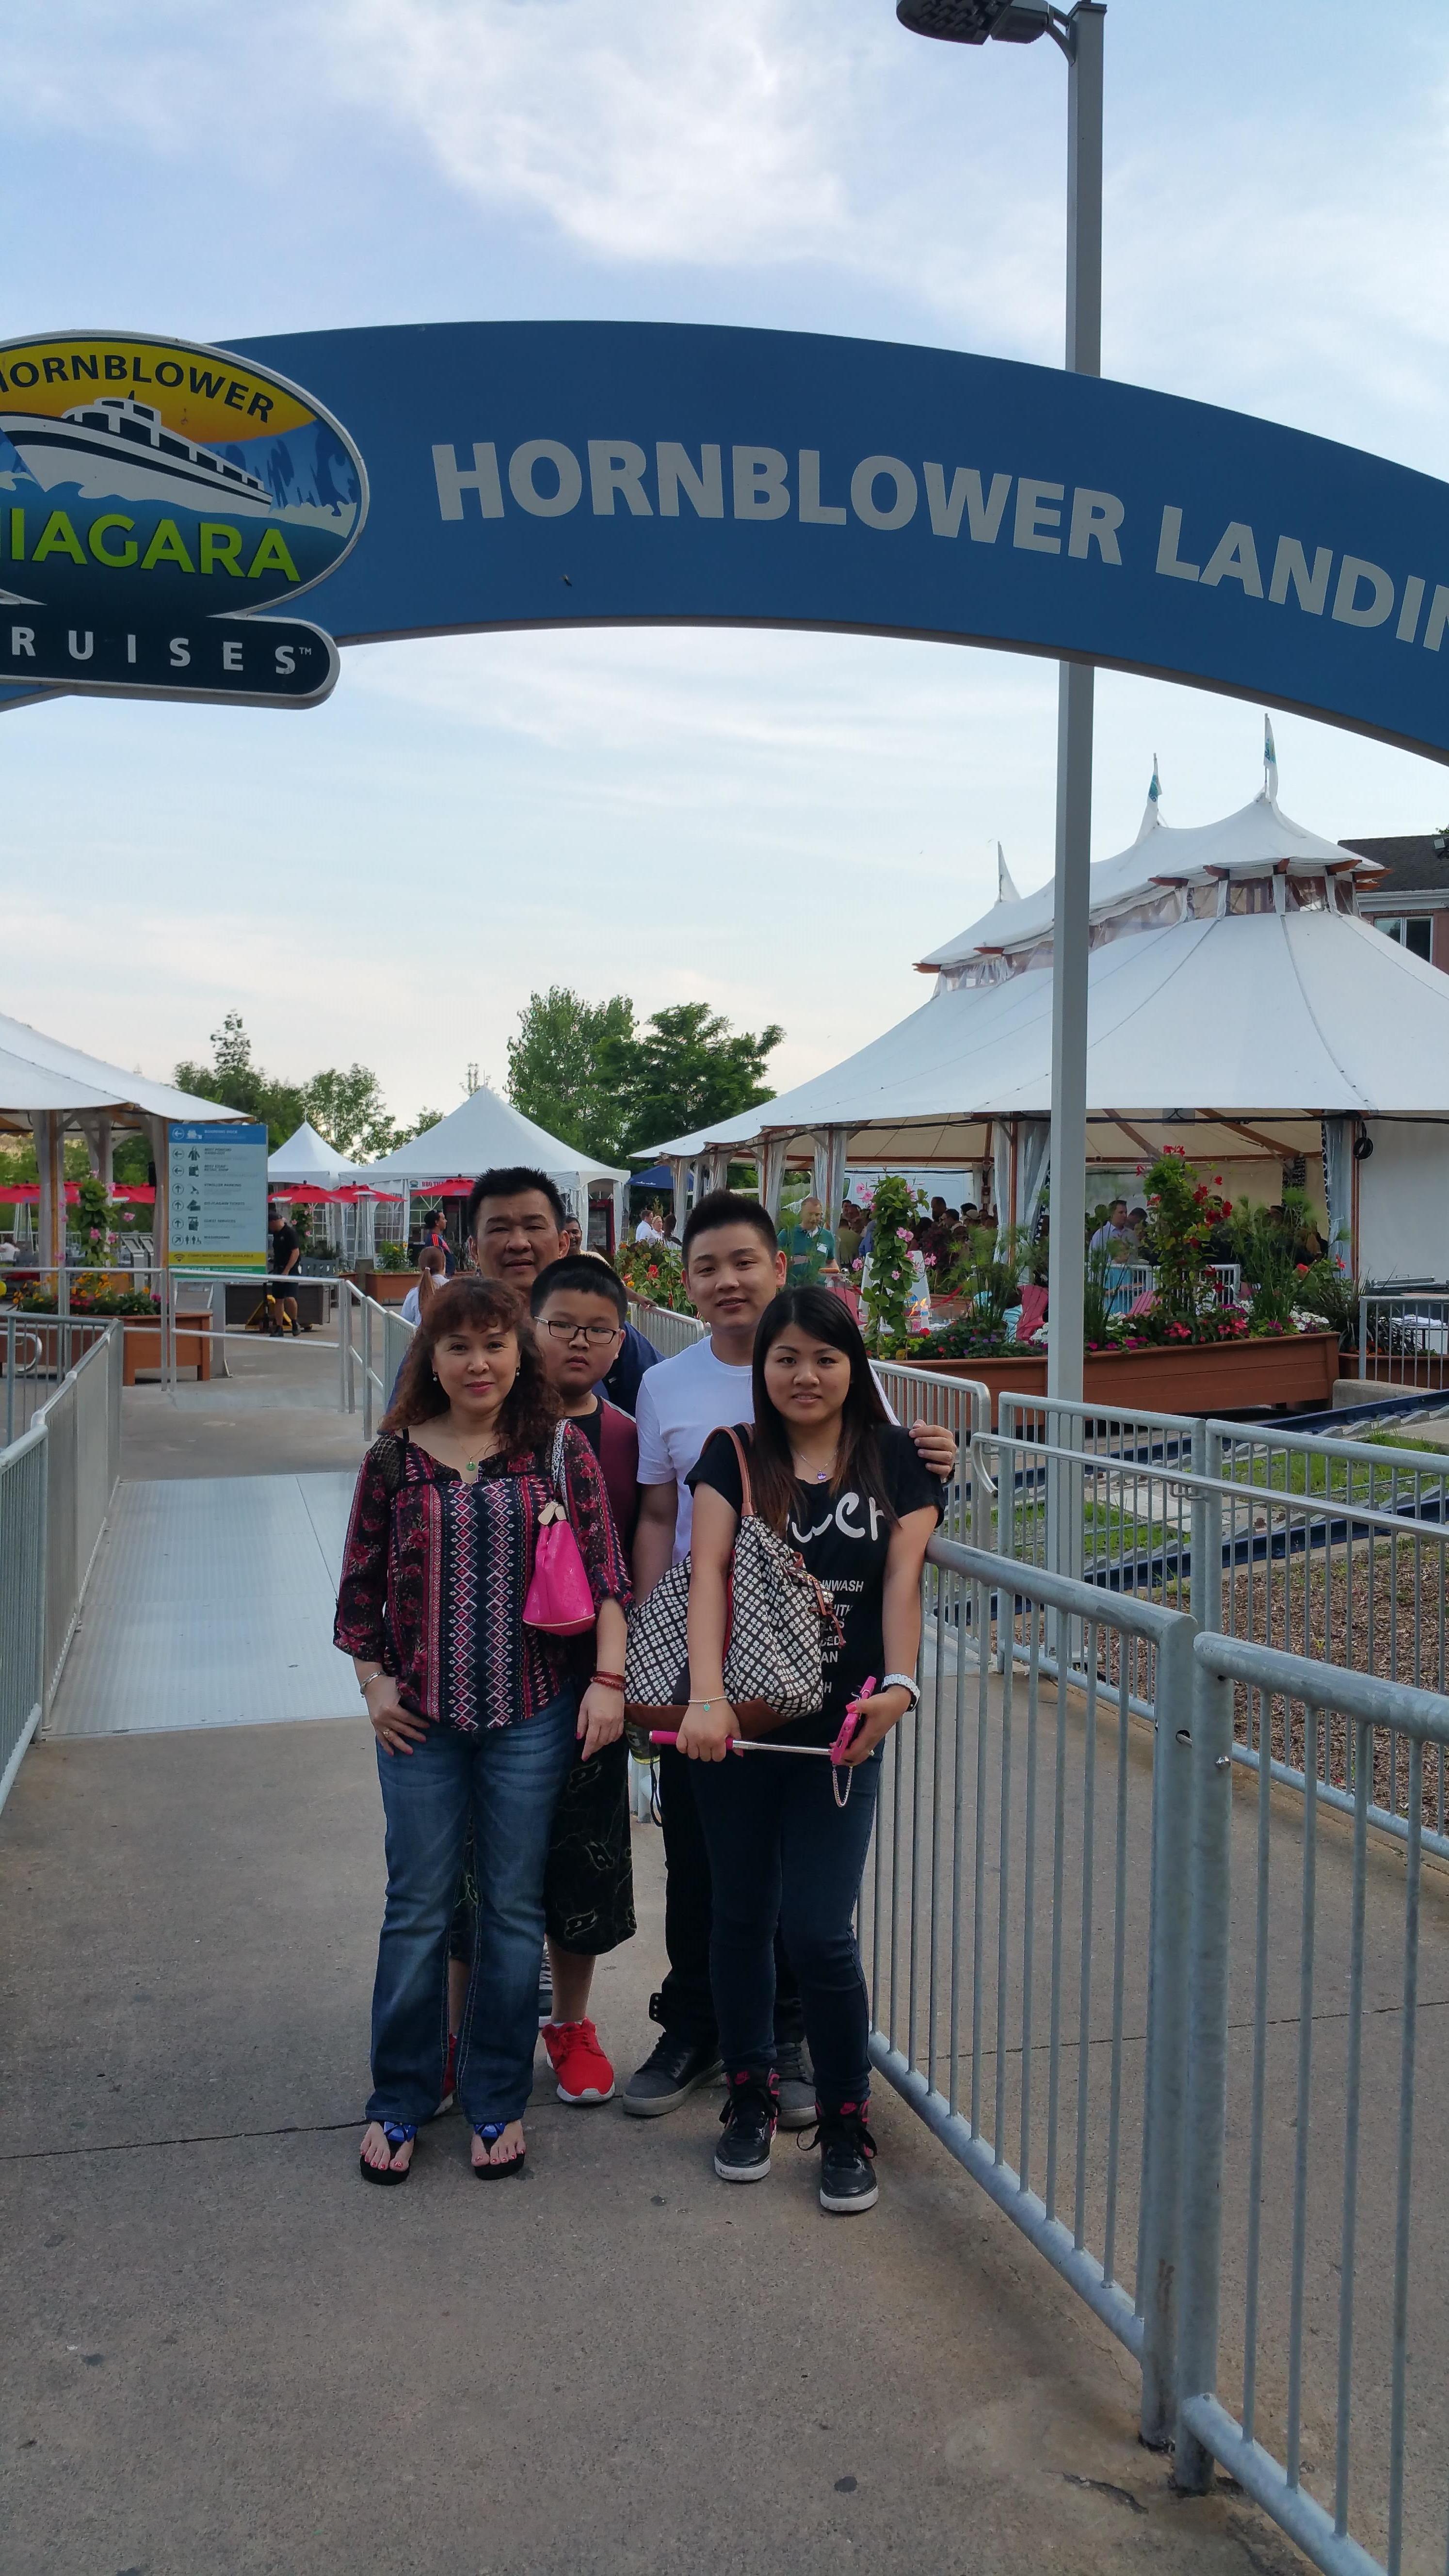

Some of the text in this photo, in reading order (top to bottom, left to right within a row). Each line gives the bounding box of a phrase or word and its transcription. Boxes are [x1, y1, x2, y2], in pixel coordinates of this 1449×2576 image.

[0, 355, 274, 423] ORNBLOWER
[432, 439, 1125, 565] HORNBLOWER
[0, 508, 301, 582] IAGARA
